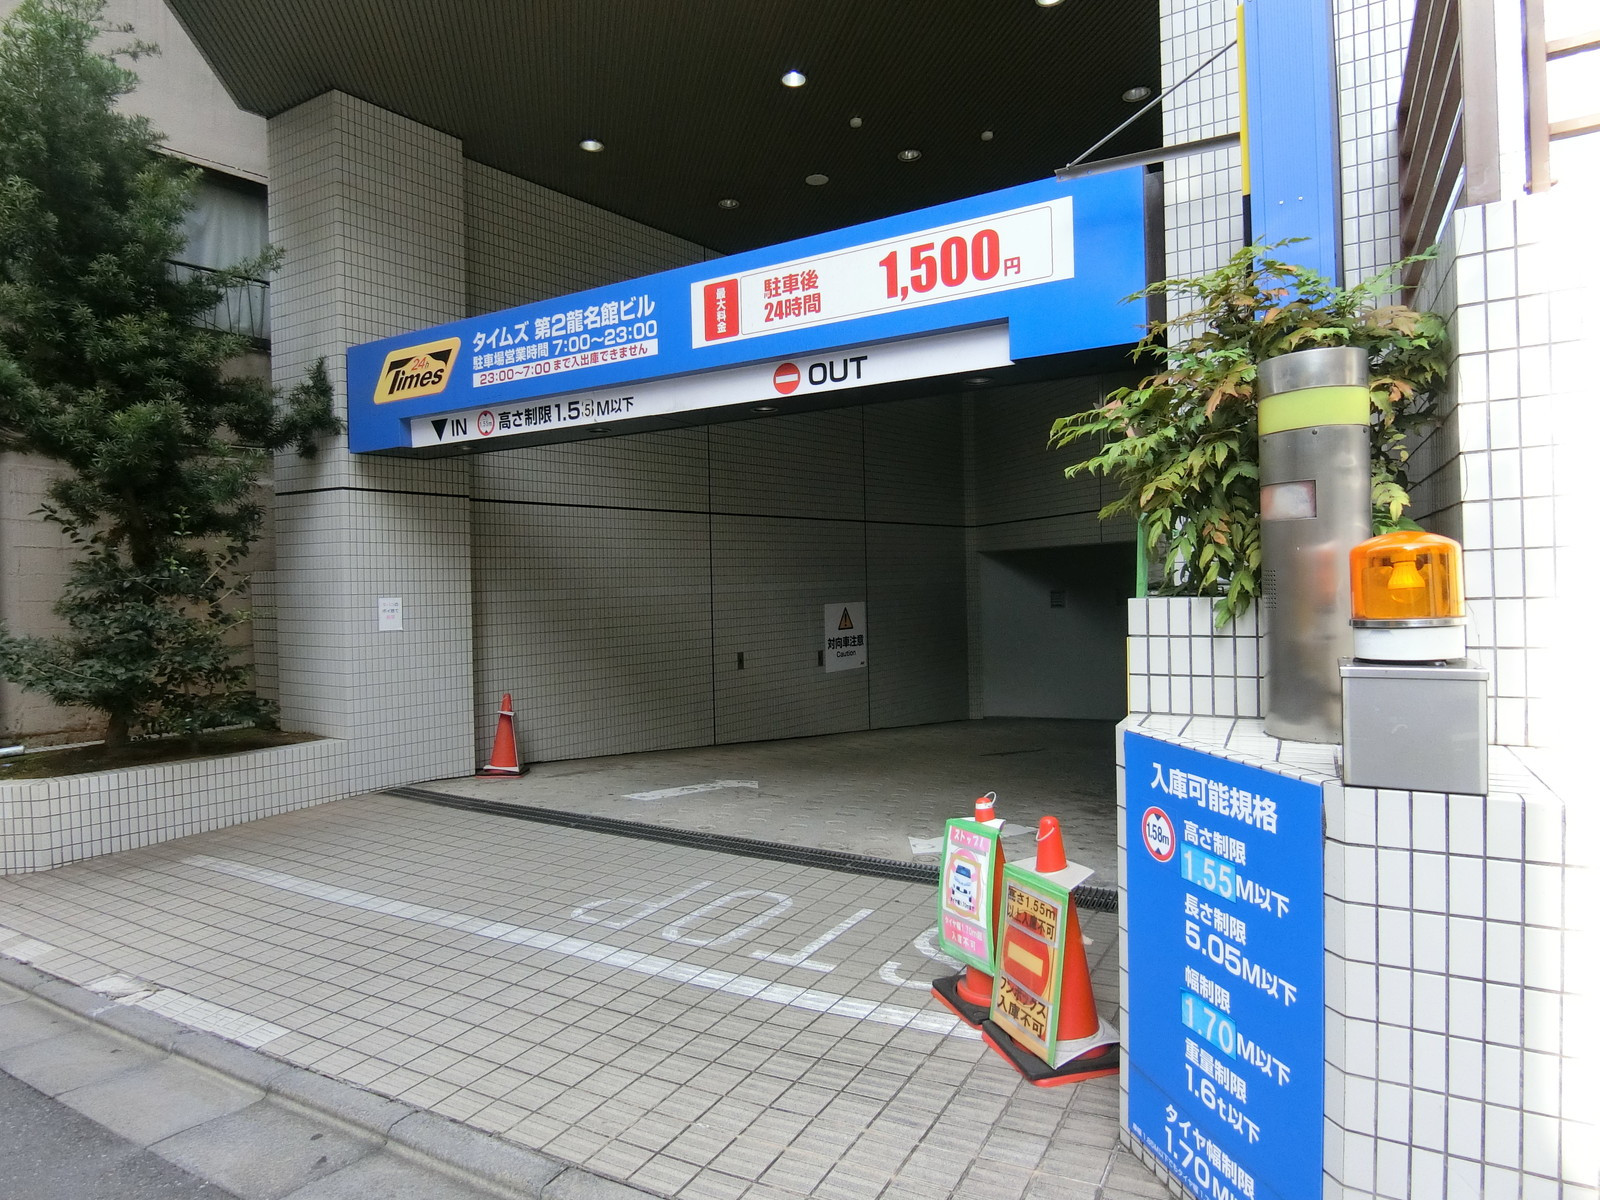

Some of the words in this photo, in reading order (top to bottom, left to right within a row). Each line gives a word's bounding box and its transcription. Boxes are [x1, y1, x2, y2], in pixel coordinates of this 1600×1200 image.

[763, 269, 819, 300] 駐車後
[473, 320, 530, 353] タイムズ
[534, 294, 656, 341] 第2龍名館ビル
[716, 287, 728, 334] 最大料金
[764, 292, 821, 323] 24時間
[386, 361, 445, 396] Times
[473, 343, 549, 371] 駐車場営業時間
[553, 343, 648, 371] まで入出庫できません
[808, 355, 868, 386] OUT
[451, 418, 468, 437] IN
[827, 634, 865, 650] 対向車注意
[836, 650, 857, 658] Caution
[1150, 762, 1278, 834] 入庫可能規格
[1146, 822, 1170, 846] 1.58m
[1183, 819, 1247, 866] 高さ制限
[1184, 893, 1247, 946] 長さ制限
[1185, 919, 1297, 1007] 5.05M以下
[1184, 964, 1231, 1014] 幅制限
[997, 994, 1045, 1039] 入庫不可
[1184, 1037, 1247, 1104] 重量制限
[1185, 1063, 1261, 1144] 1.6t以下
[1165, 1103, 1255, 1200] タイヤ幅制限
